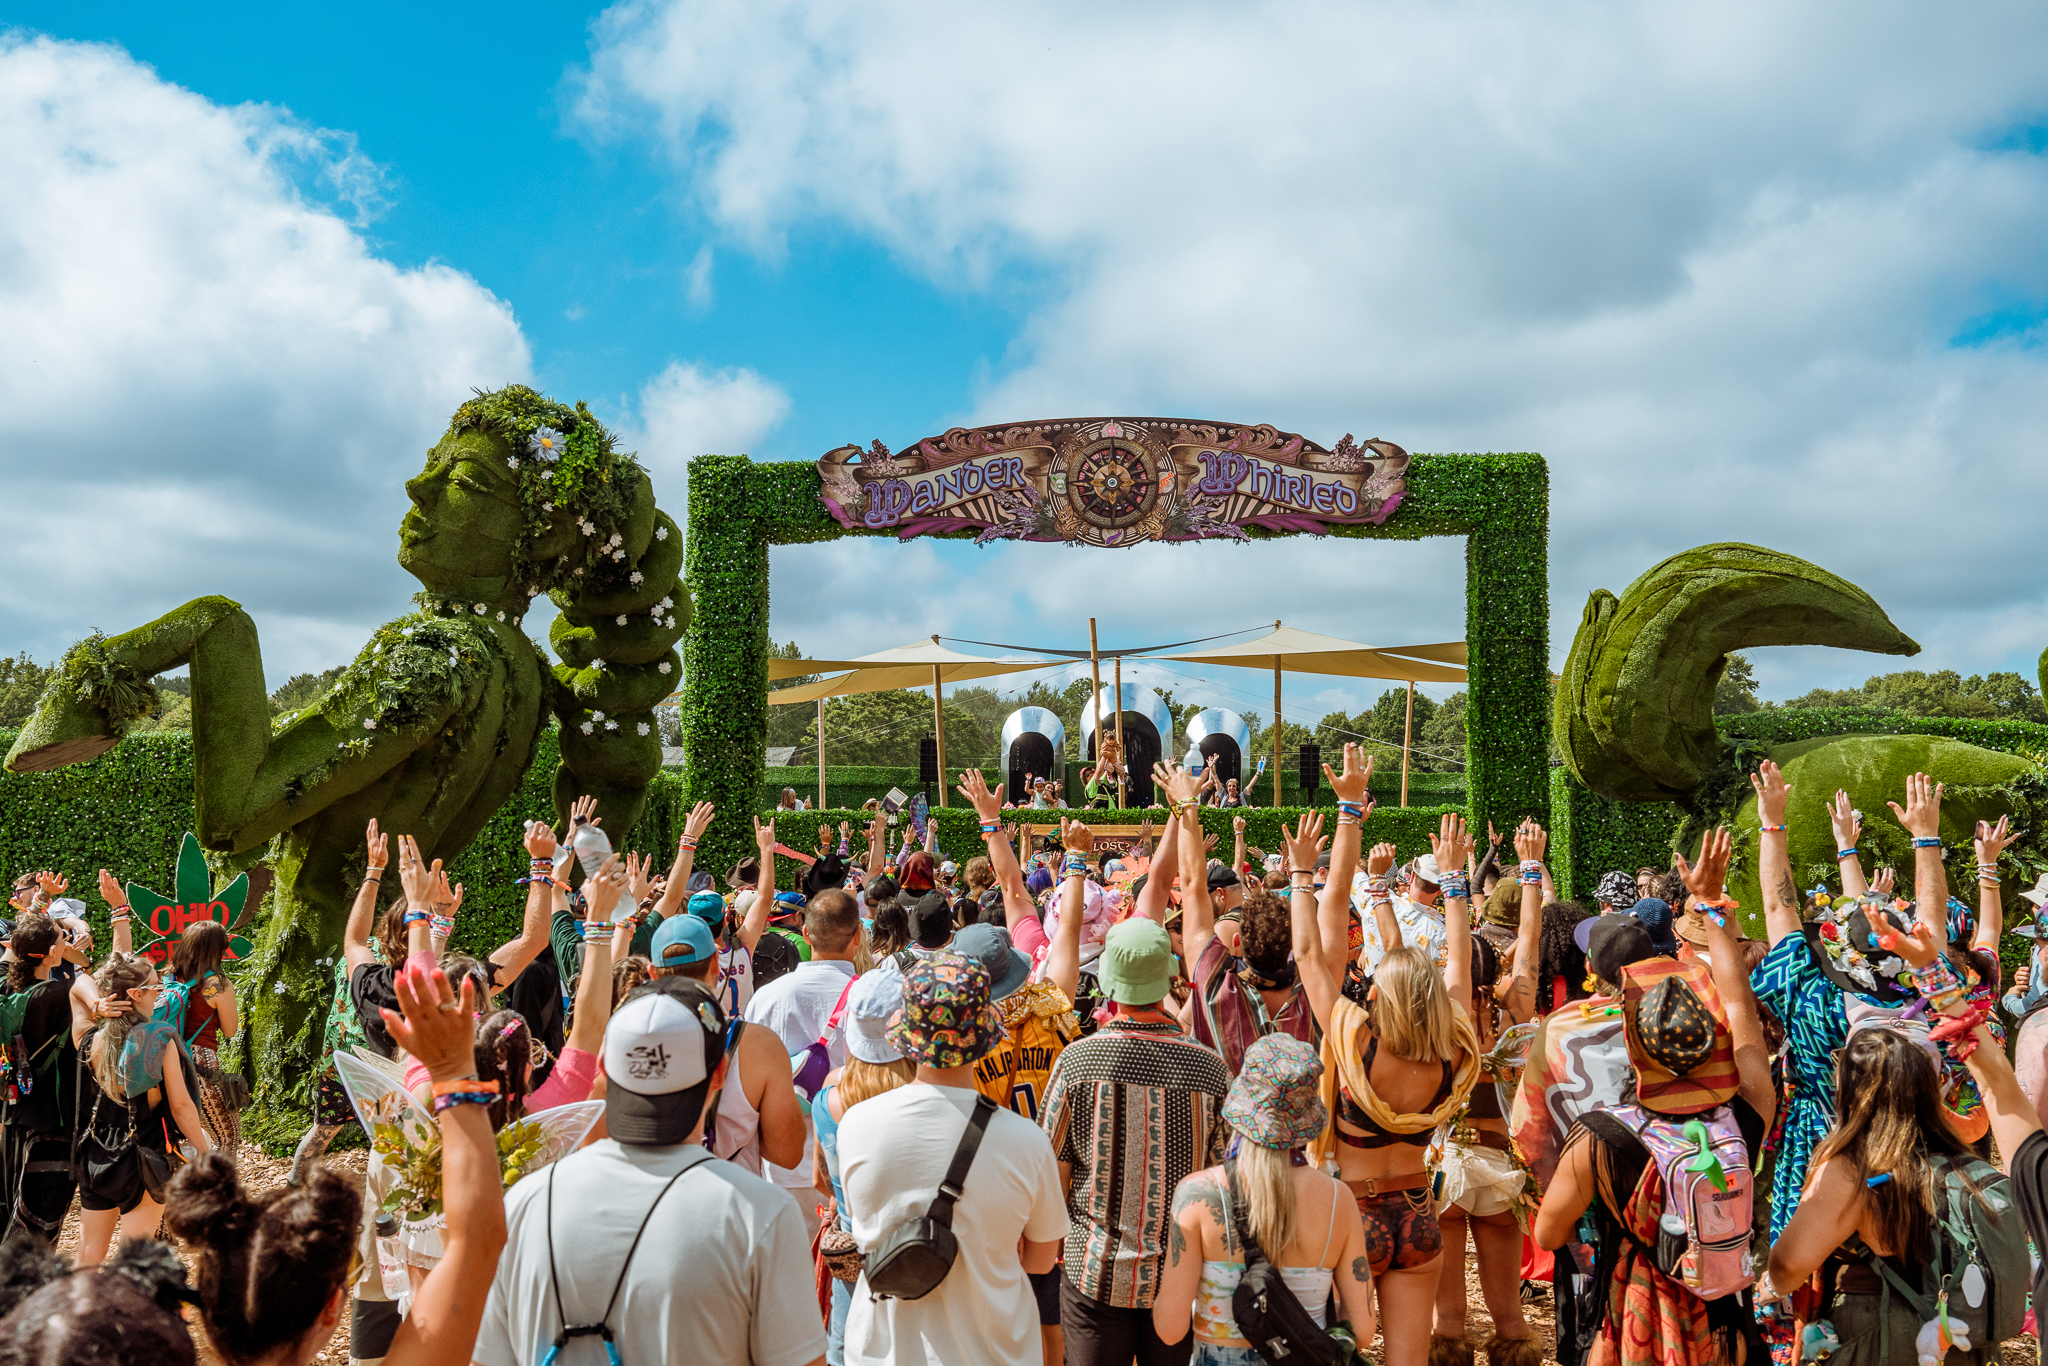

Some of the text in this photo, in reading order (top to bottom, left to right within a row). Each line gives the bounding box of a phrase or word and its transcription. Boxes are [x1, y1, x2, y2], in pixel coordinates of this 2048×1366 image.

[1093, 841, 1131, 852] LOST?
[150, 900, 230, 936] OHIO
[728, 977, 740, 1017] 1
